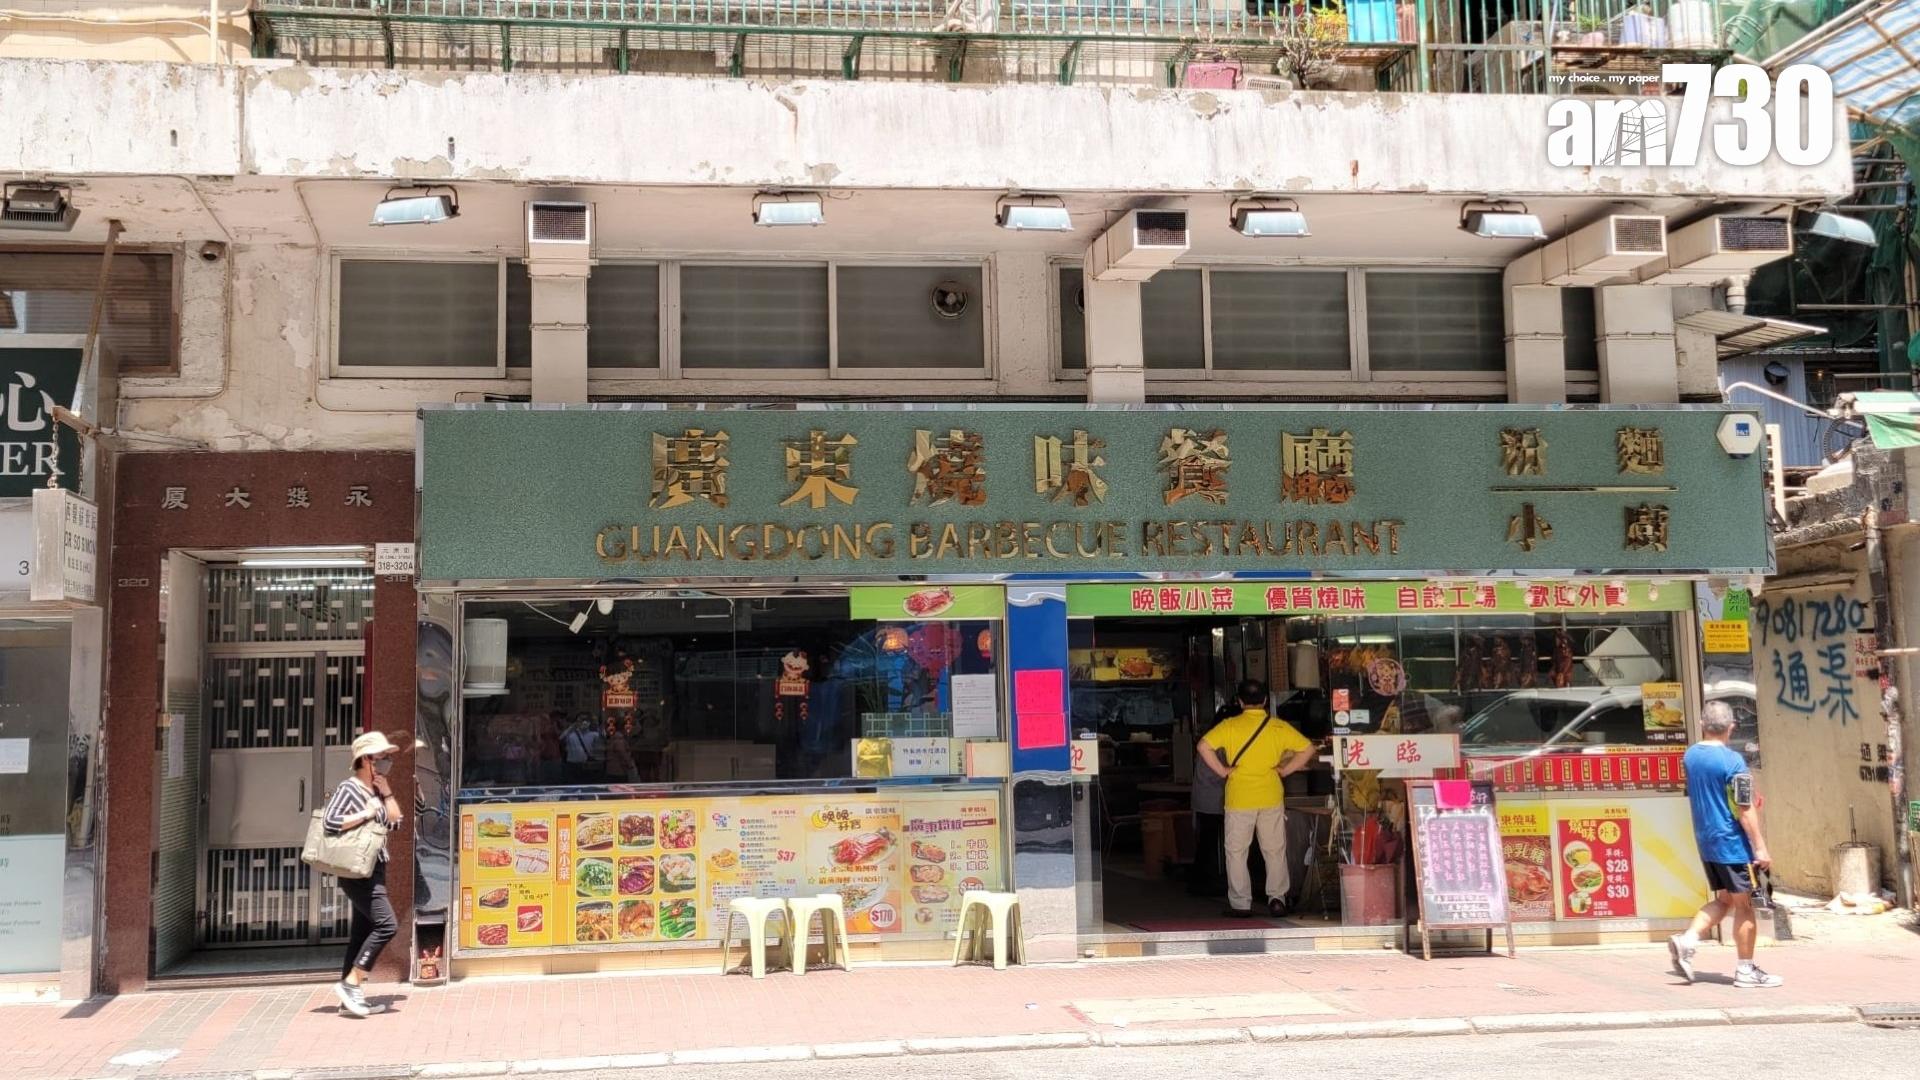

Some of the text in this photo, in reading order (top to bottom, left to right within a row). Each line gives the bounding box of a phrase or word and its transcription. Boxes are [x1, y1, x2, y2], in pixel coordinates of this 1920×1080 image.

[0, 371, 57, 431] 心
[596, 518, 1403, 563] GUANGDONG BARBECUE RESTAURANT
[377, 561, 413, 571] 318-320A
[1132, 587, 1234, 611] 晚飯小菜
[1264, 587, 1366, 611] 優質燒味
[1348, 739, 1421, 766] 光臨
[777, 849, 796, 861] $37
[1606, 859, 1628, 873] $28
[1606, 884, 1629, 898] $30
[871, 909, 893, 922] $170
